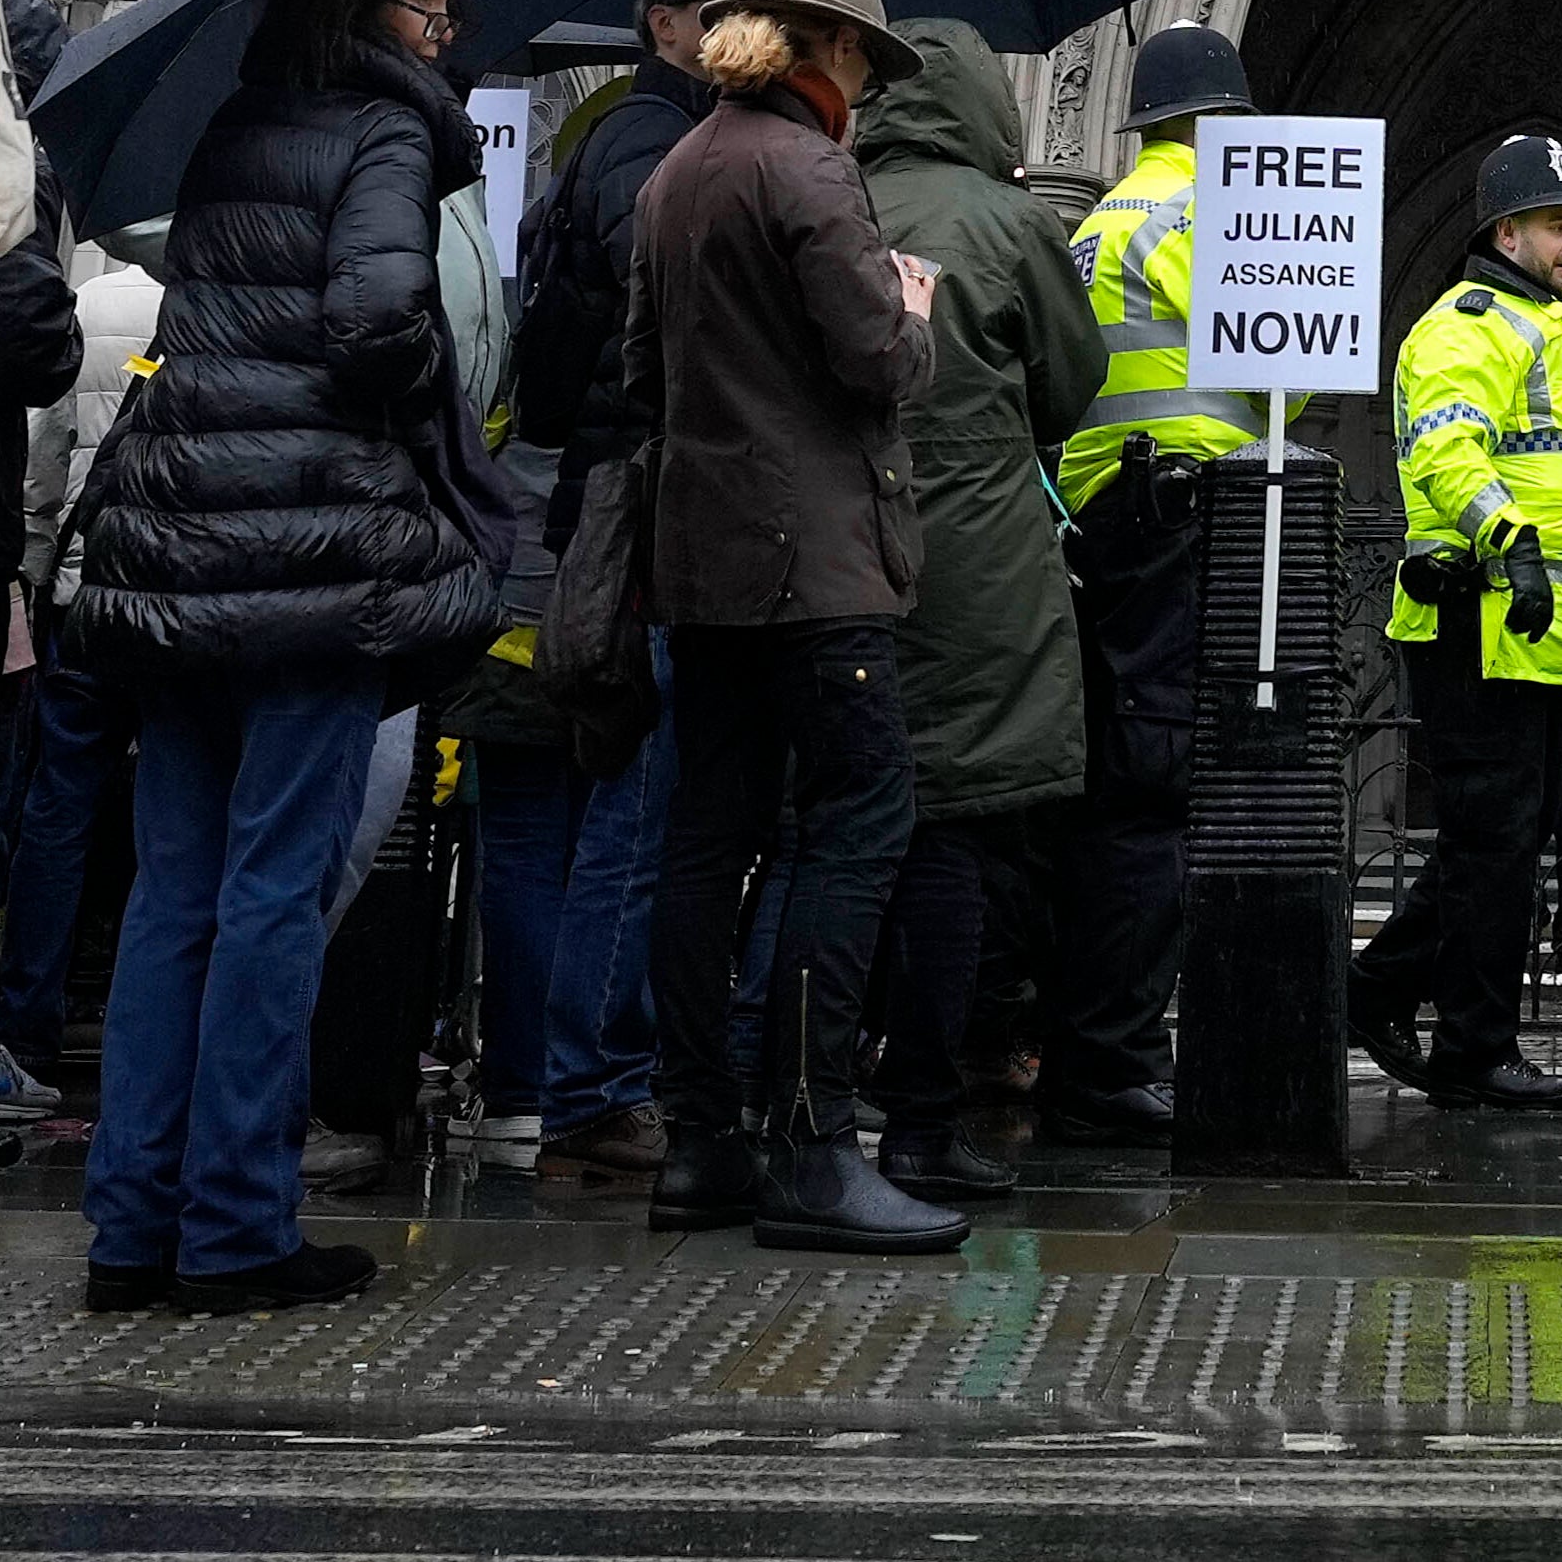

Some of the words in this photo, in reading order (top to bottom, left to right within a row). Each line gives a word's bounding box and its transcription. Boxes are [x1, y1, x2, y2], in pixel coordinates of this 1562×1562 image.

[1222, 146, 1362, 189] FREE
[1224, 213, 1354, 242] JULIAN
[1221, 264, 1355, 287] ASSANGE
[1212, 311, 1360, 356] NOW!
